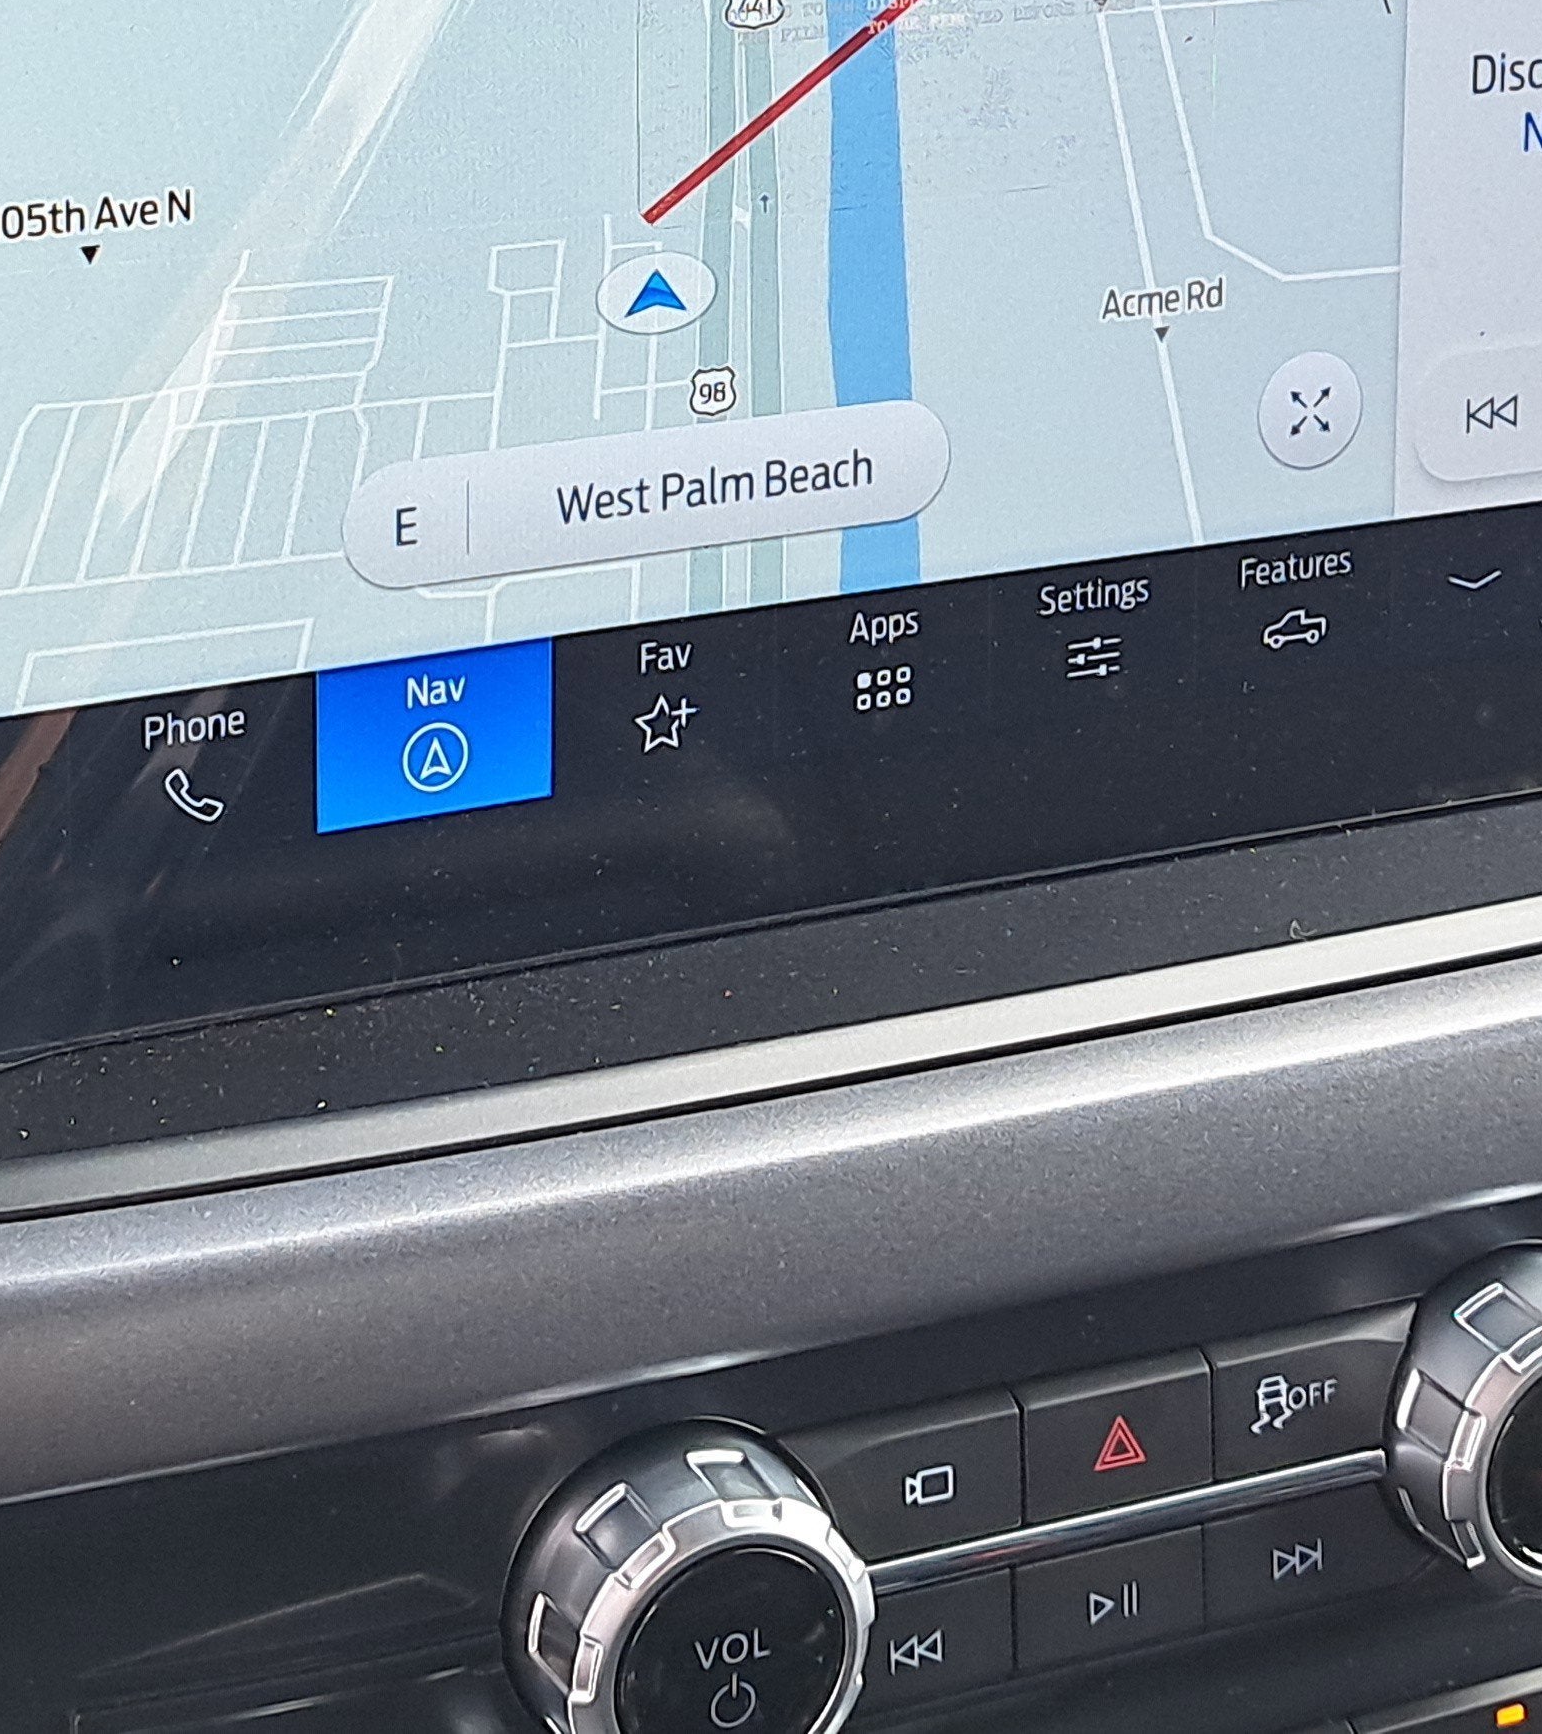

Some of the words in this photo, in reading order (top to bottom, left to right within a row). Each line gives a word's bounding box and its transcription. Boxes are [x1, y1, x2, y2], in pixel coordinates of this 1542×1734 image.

[94, 196, 159, 230] Ave
[167, 190, 193, 224] N
[1100, 289, 1180, 322] Acme
[1186, 278, 1224, 314] Rd
[698, 380, 727, 406] 98
[558, 477, 650, 525] West
[660, 463, 755, 514] Palm
[764, 448, 874, 500] Beach
[395, 506, 419, 547] E
[1239, 547, 1354, 590] Features
[1036, 574, 1151, 617] Settings
[848, 609, 920, 648] Apps
[638, 641, 693, 674] Fav
[405, 674, 467, 710] Nav
[143, 708, 247, 750] Phone
[1288, 1377, 1337, 1412] OFF
[694, 1626, 772, 1672] VOL
